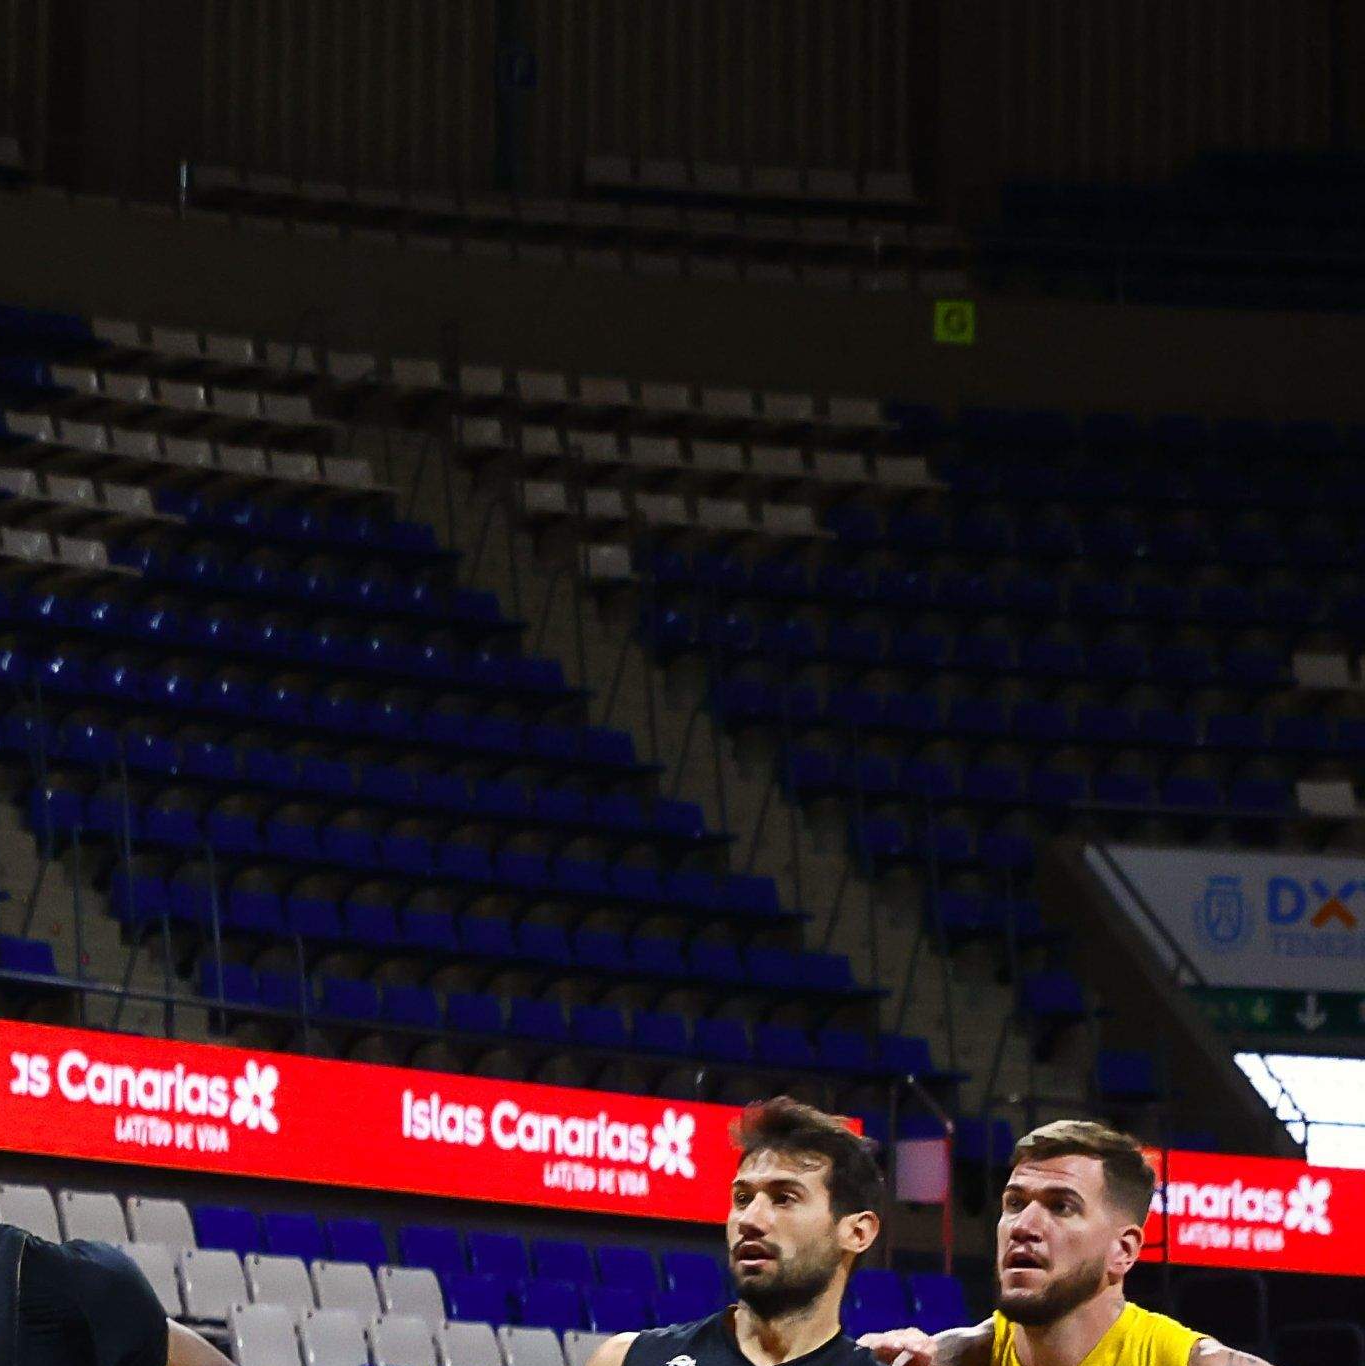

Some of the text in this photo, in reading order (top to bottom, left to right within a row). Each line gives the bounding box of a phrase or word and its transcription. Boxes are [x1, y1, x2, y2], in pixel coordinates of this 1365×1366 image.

[1268, 874, 1365, 927] DX
[57, 1049, 231, 1118] Canarias
[402, 1088, 649, 1165] Islas Canarias
